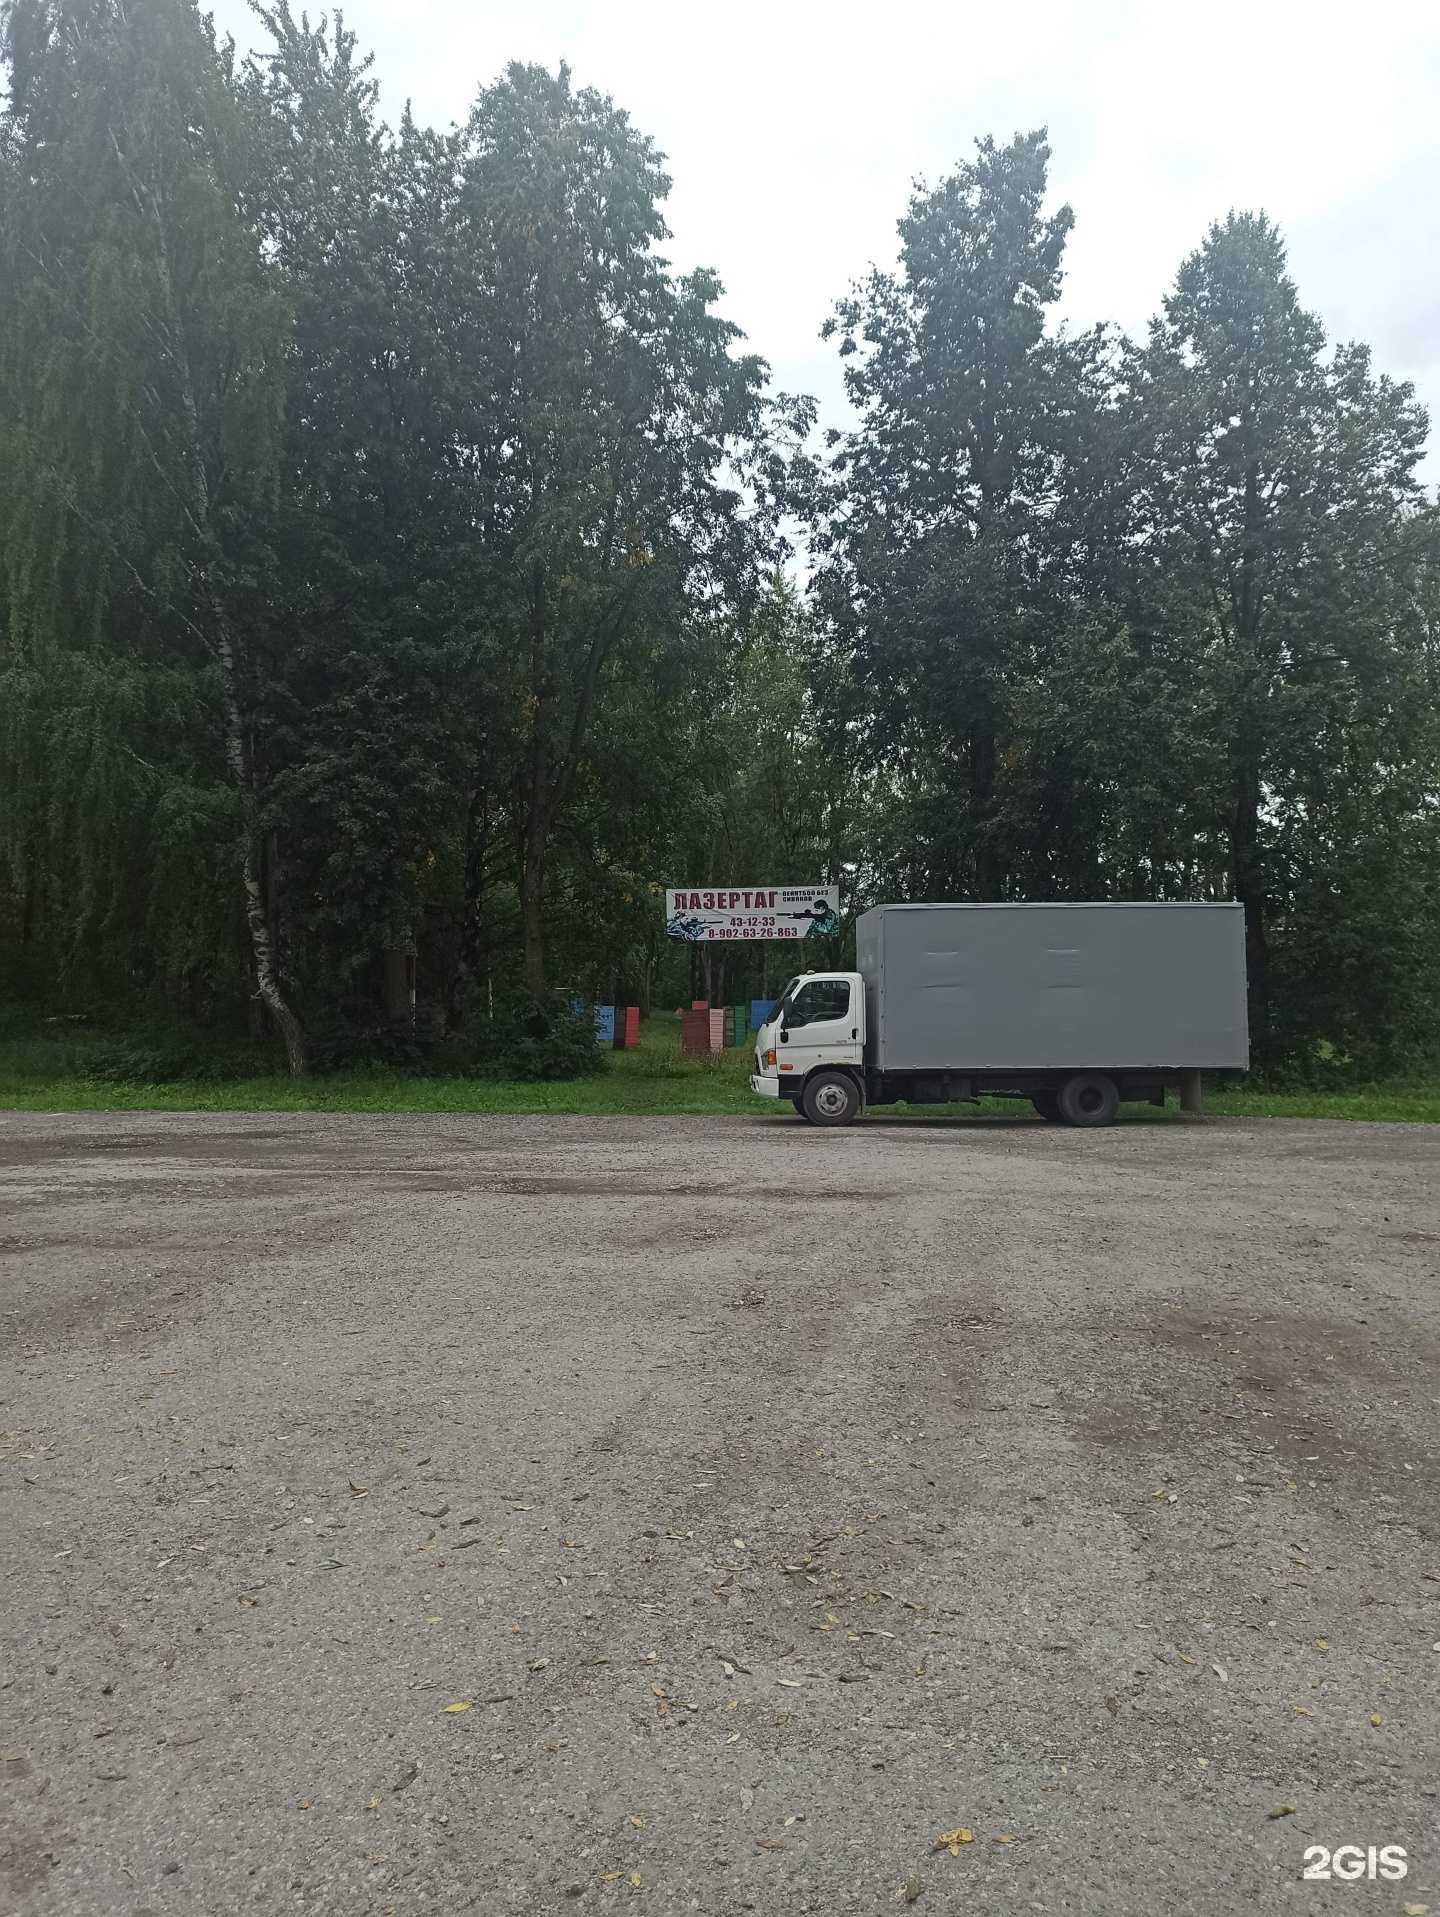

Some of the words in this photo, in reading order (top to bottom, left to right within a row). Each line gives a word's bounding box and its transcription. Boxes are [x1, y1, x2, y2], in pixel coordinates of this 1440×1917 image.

[673, 891, 779, 910] ЛАЗЕРТАГ
[729, 917, 776, 927] 43-12-33
[708, 927, 798, 939] 8-902-63-26-863
